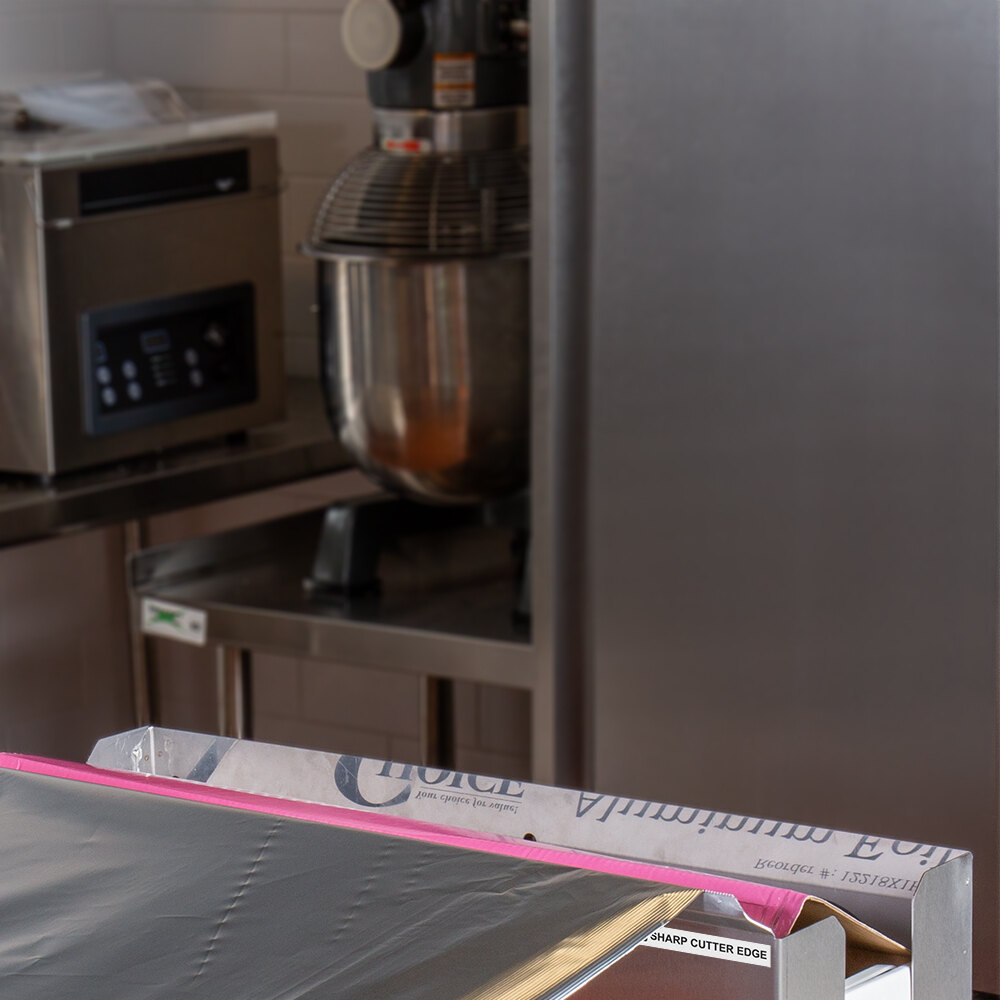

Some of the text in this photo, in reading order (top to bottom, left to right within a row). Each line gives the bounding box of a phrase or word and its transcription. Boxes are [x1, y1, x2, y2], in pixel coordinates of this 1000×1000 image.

[650, 932, 768, 960] SHARP CUTTER EDGE
